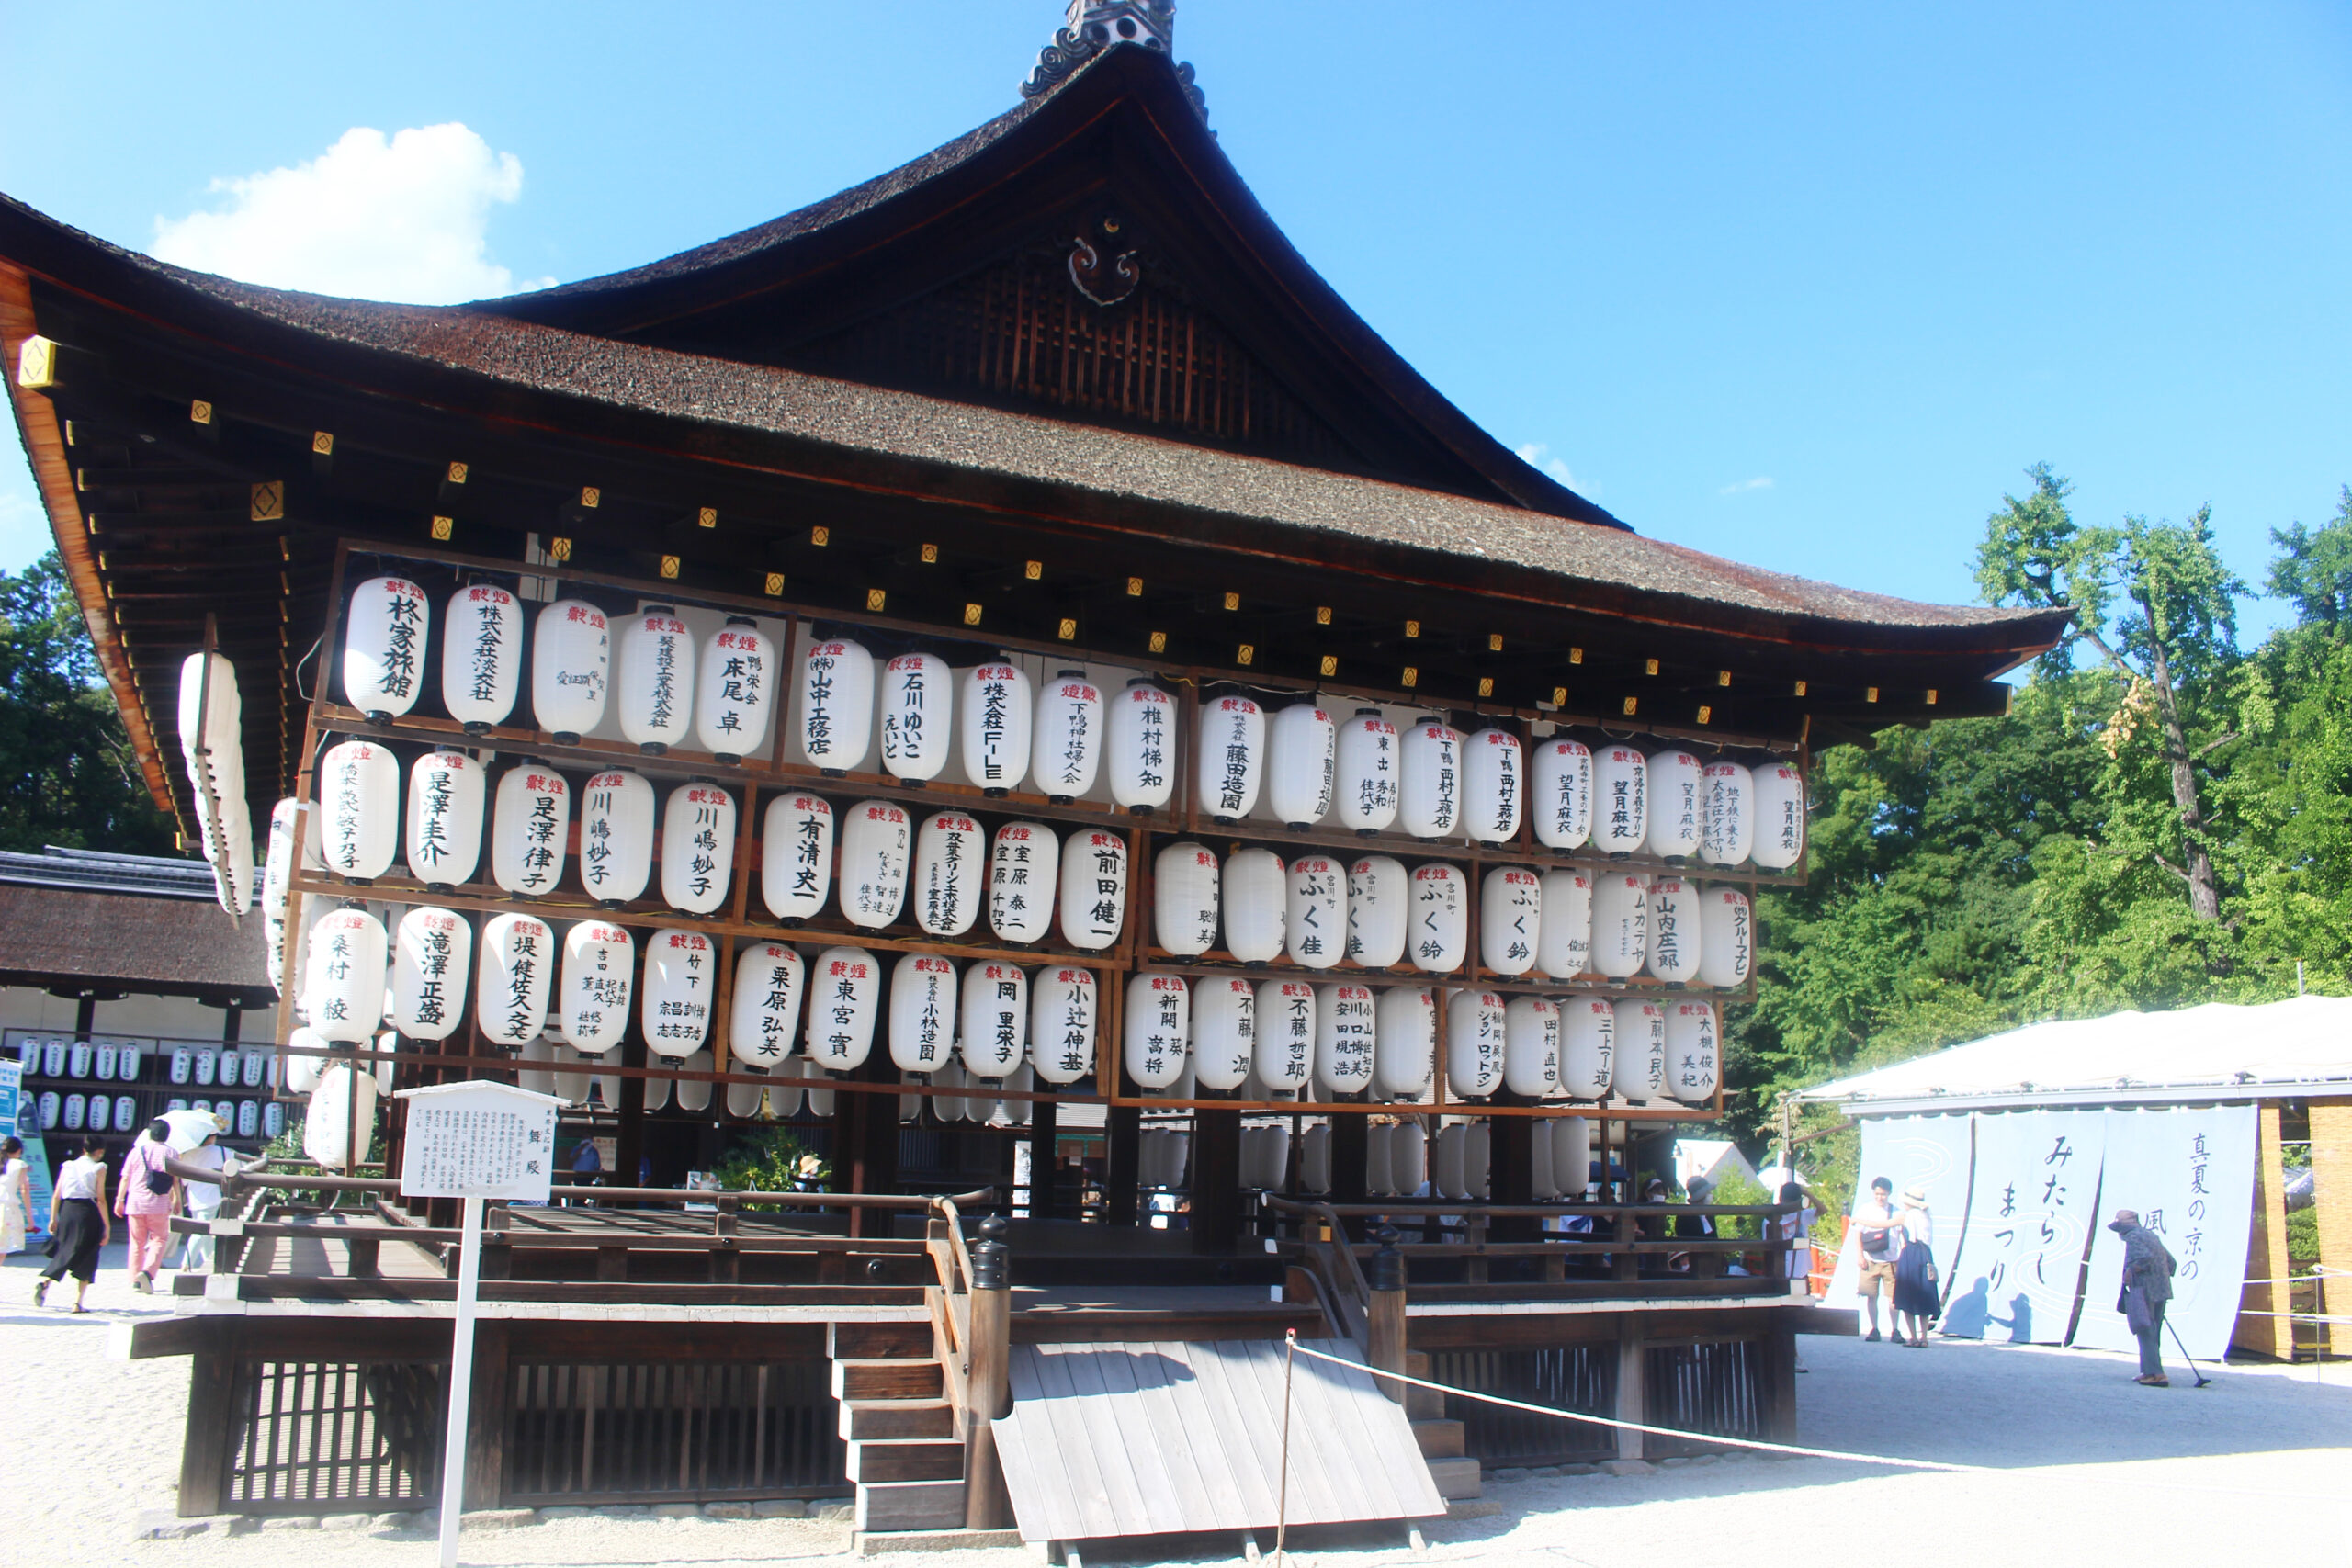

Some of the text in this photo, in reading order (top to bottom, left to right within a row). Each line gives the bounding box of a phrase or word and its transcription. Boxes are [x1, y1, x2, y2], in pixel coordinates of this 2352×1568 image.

[379, 595, 423, 698] 柊家旅館
[469, 605, 503, 702] 株式会社淡交社
[1064, 703, 1087, 784] 下鴨神社婦人会
[1360, 779, 1376, 816] 佳代子
[1556, 774, 1574, 832] 望月麻衣
[1611, 781, 1630, 838] 望月麻衣
[1680, 783, 1694, 840] 望月麻衣
[1781, 801, 1793, 850] 望月麻衣
[522, 796, 559, 888] 是澤律子
[1090, 850, 1121, 936] 前田健一
[757, 966, 790, 1057] 栗原弘美
[1990, 1180, 2016, 1291] まつり
[2035, 1135, 2072, 1284] みたらし
[2180, 1133, 2211, 1279] 真夏の京の
